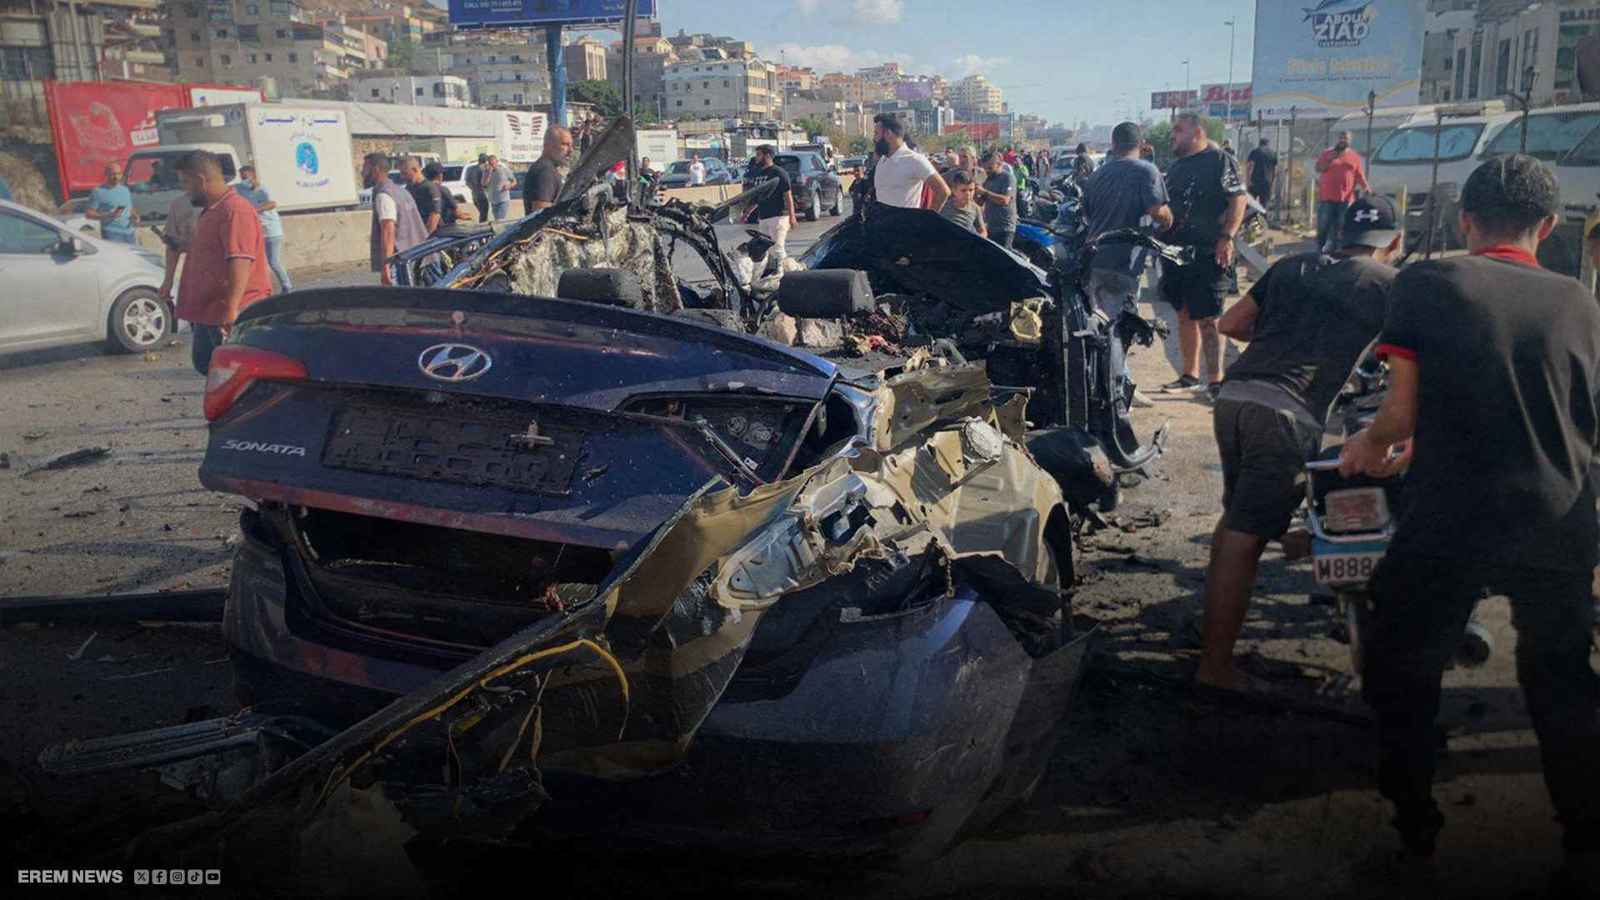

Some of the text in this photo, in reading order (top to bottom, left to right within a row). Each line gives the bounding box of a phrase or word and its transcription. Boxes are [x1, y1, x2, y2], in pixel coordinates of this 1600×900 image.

[1324, 13, 1363, 25] ABOU
[1314, 24, 1369, 40] ZIAD
[1203, 86, 1252, 102] Bat
[221, 440, 306, 457] SONATA
[1317, 556, 1379, 580] M888
